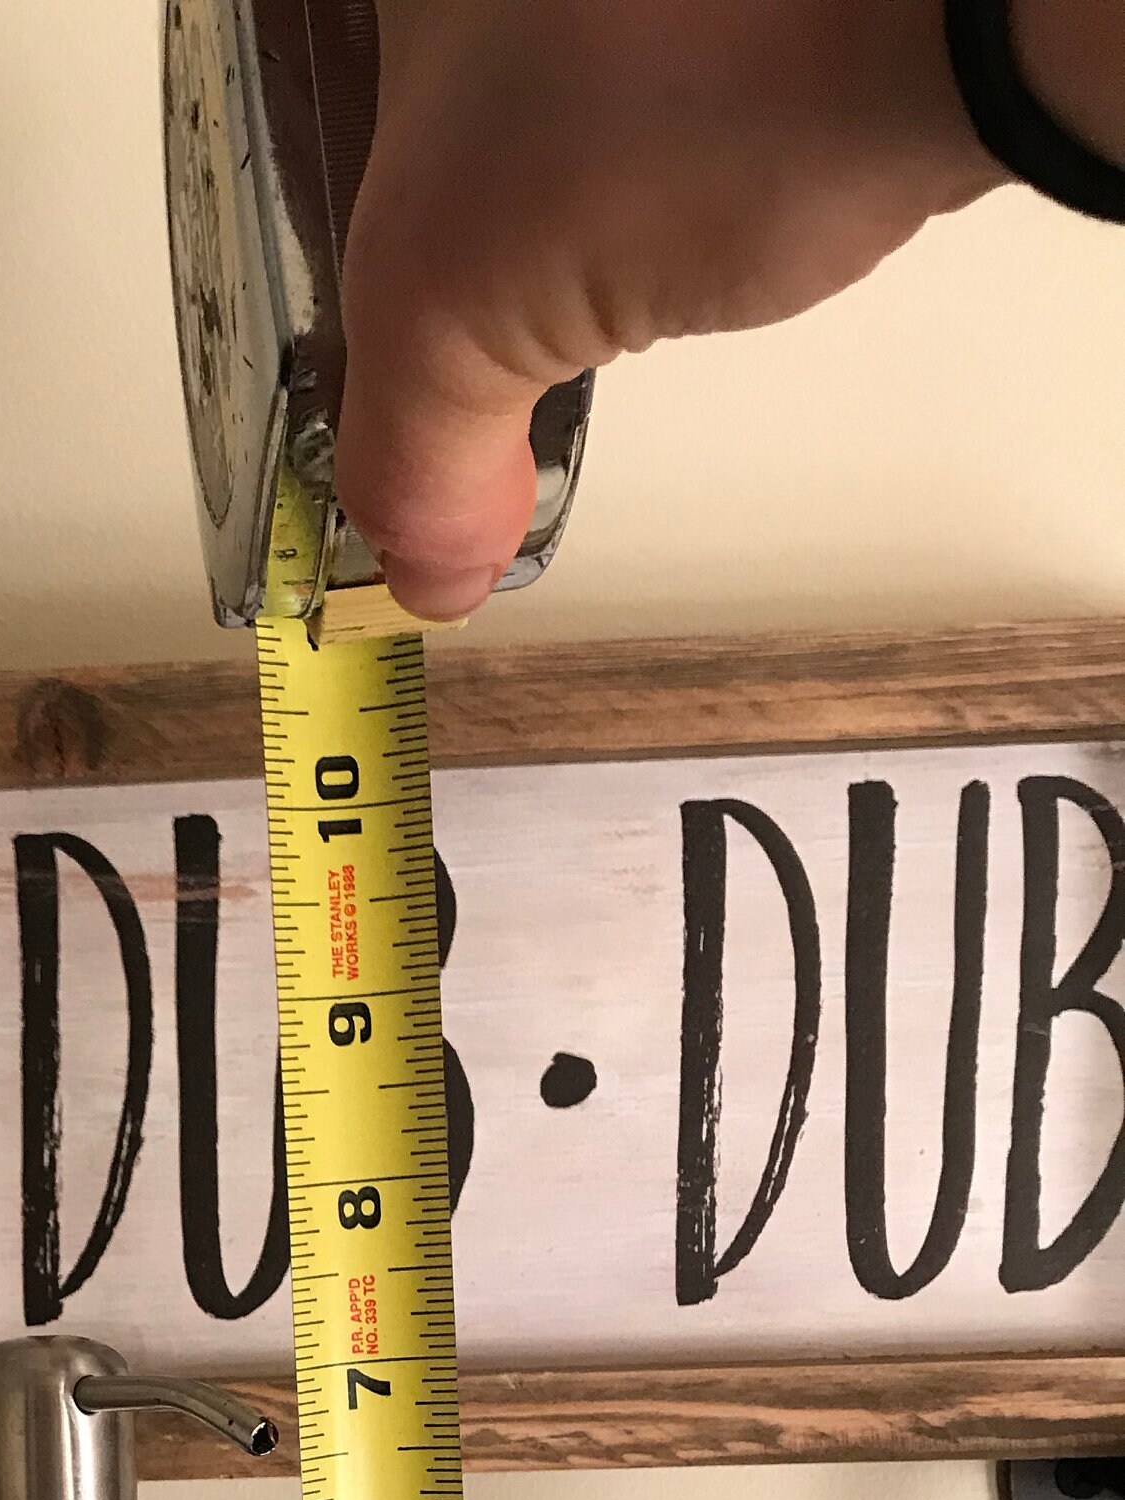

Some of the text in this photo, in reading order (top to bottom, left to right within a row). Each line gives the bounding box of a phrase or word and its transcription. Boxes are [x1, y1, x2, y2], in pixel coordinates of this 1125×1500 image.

[315, 755, 362, 843] 10
[328, 869, 344, 978] THE STANLEY
[345, 920, 359, 981] WORKS
[13, 812, 475, 1328] DU
[675, 774, 1125, 1308] DUB
[328, 1001, 373, 1047] 9
[337, 1185, 381, 1230] 8
[348, 1277, 364, 1355] P.R. APP'D
[362, 1274, 379, 1355] NO. 339 TC
[347, 1368, 391, 1411] 7
